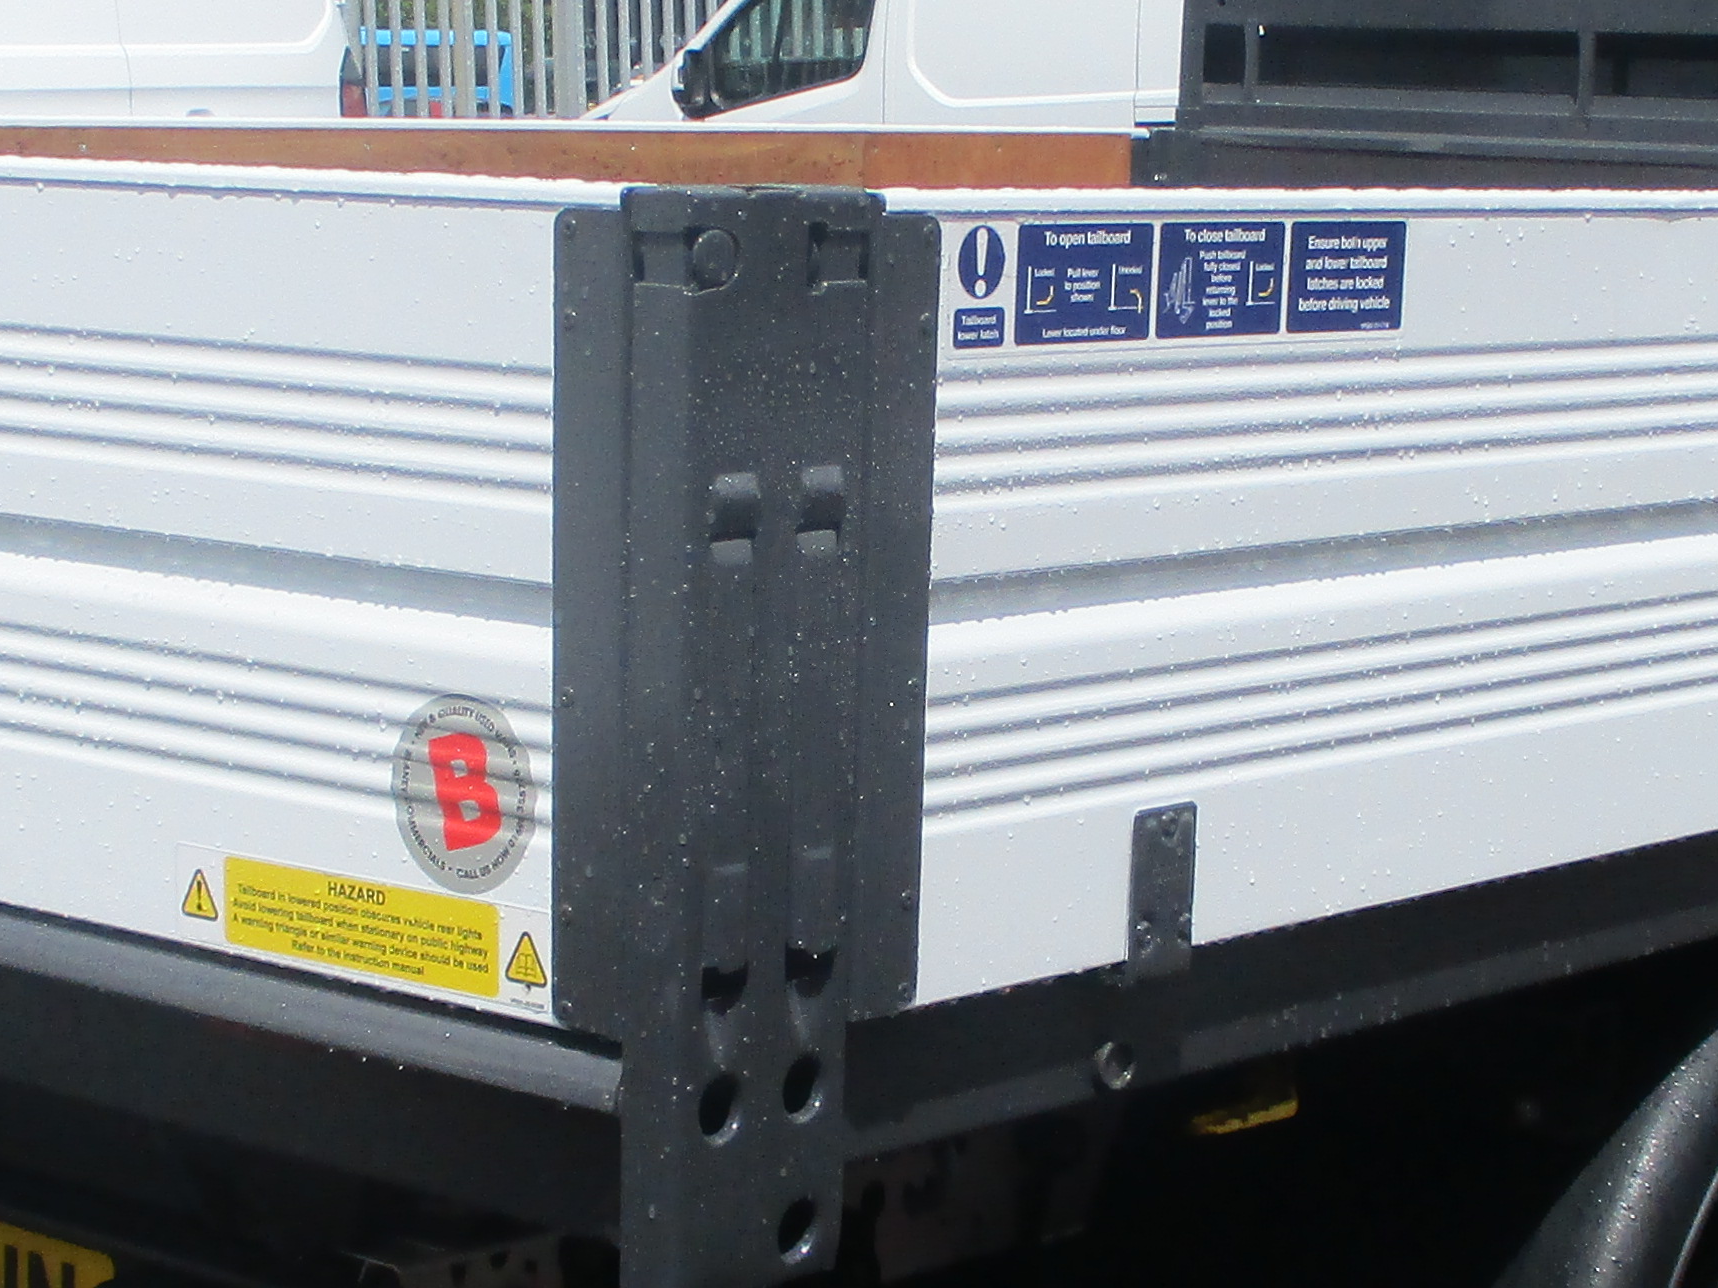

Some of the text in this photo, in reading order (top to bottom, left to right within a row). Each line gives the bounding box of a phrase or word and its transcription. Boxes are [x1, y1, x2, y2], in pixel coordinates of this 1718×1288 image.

[1044, 230, 1131, 249] To open tailboard
[1184, 227, 1266, 243] To close tailboard
[1308, 235, 1388, 252] Ensure both upper
[1305, 255, 1388, 270] and lower tailboard
[1067, 267, 1099, 278] Pull lever
[1072, 281, 1101, 293] position
[1307, 275, 1385, 290] latches are locked
[1298, 295, 1390, 313] before driving vehicle
[961, 315, 997, 326] Tailboard
[957, 330, 979, 341] lower
[1042, 324, 1126, 339] Lever located under floor
[427, 732, 503, 852] B
[327, 881, 386, 906] HAZARD
[236, 883, 275, 901] Tailboard
[287, 893, 321, 910] lowered
[323, 902, 358, 918] position
[360, 909, 401, 925] obscures
[403, 917, 435, 932] vehicle
[437, 924, 455, 935] rear
[456, 925, 483, 941] lights
[232, 898, 488, 960] Avoid lowering tailboard when stationary on public highway
[241, 916, 274, 933] warning
[274, 920, 308, 938] triangle
[321, 931, 350, 945] similar
[351, 938, 387, 956] warning
[389, 943, 418, 959] device
[420, 951, 451, 966] should
[453, 956, 465, 968] be
[467, 961, 489, 974] used
[291, 939, 315, 952] Refer
[327, 947, 341, 959] the
[392, 960, 425, 976] manual
